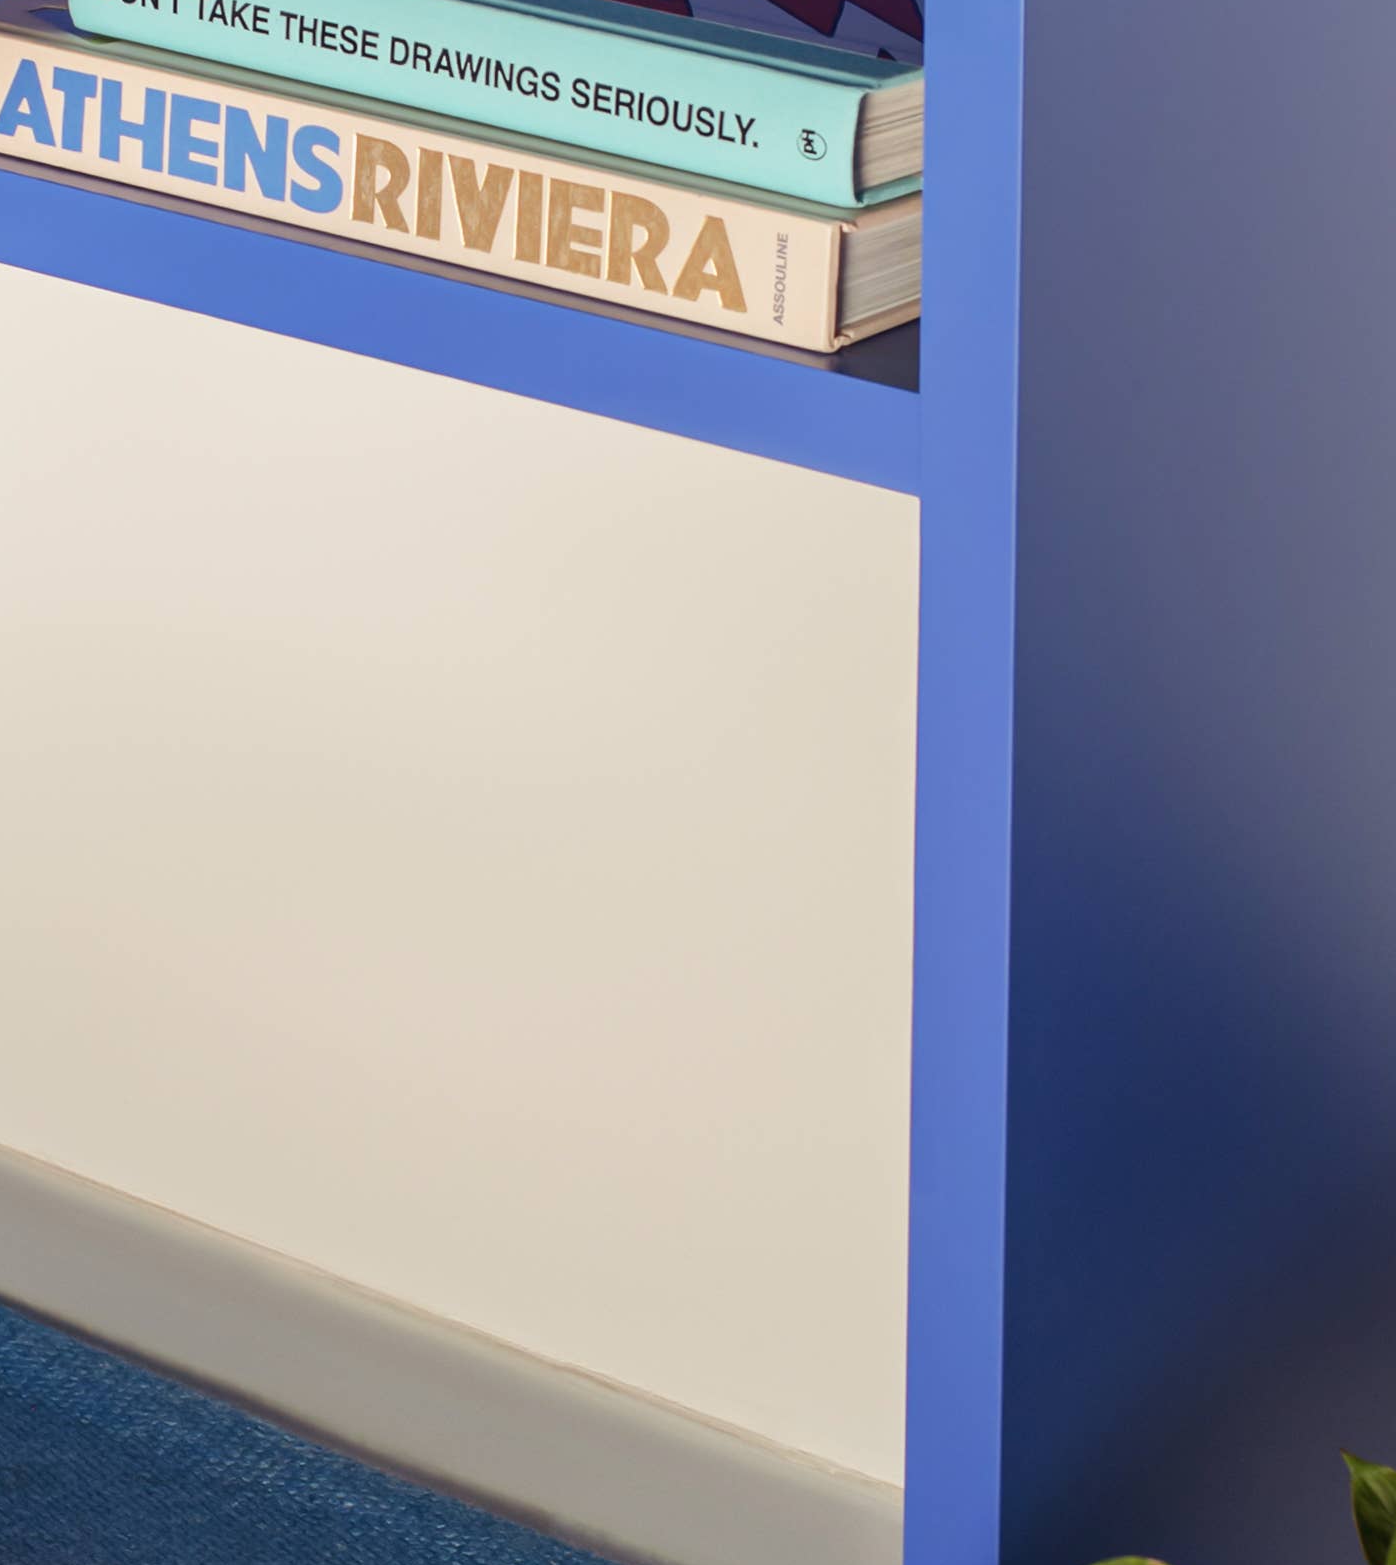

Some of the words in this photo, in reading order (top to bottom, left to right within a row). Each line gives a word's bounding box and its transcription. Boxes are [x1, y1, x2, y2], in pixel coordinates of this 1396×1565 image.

[280, 11, 379, 60] THESE
[389, 36, 561, 101] DRAWINGS
[571, 78, 759, 149] SERIOUSLY.
[772, 232, 789, 326] ASSOULINE
